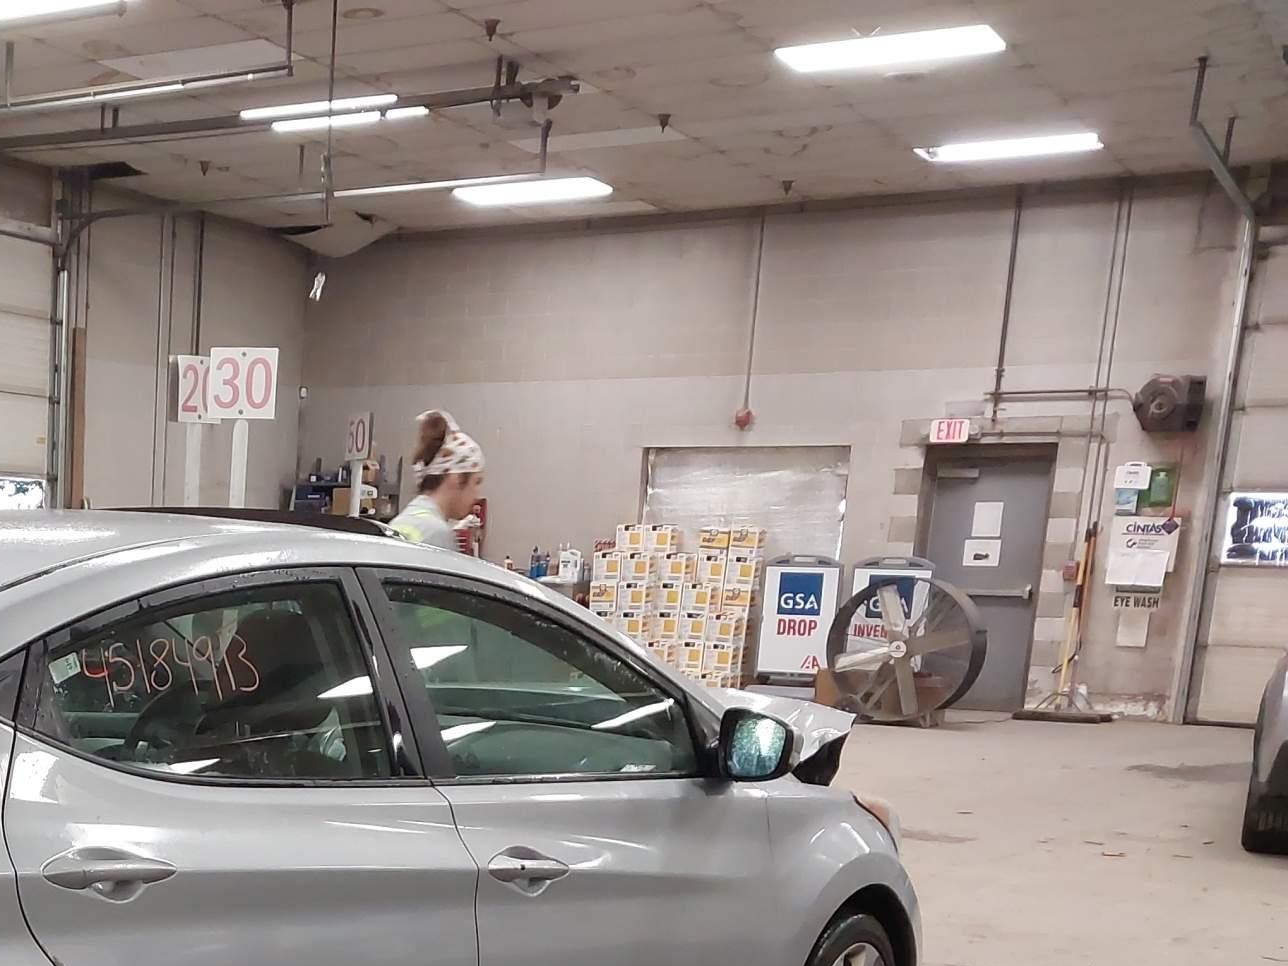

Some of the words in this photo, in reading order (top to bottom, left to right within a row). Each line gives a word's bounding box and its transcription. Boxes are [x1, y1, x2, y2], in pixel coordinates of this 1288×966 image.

[213, 356, 273, 410] 30
[936, 420, 965, 440] EXIT
[780, 592, 818, 610] GSA
[1113, 596, 1131, 608] EYE
[1133, 597, 1160, 609] WASH
[777, 618, 818, 637] DROP
[852, 623, 889, 638] INVEN
